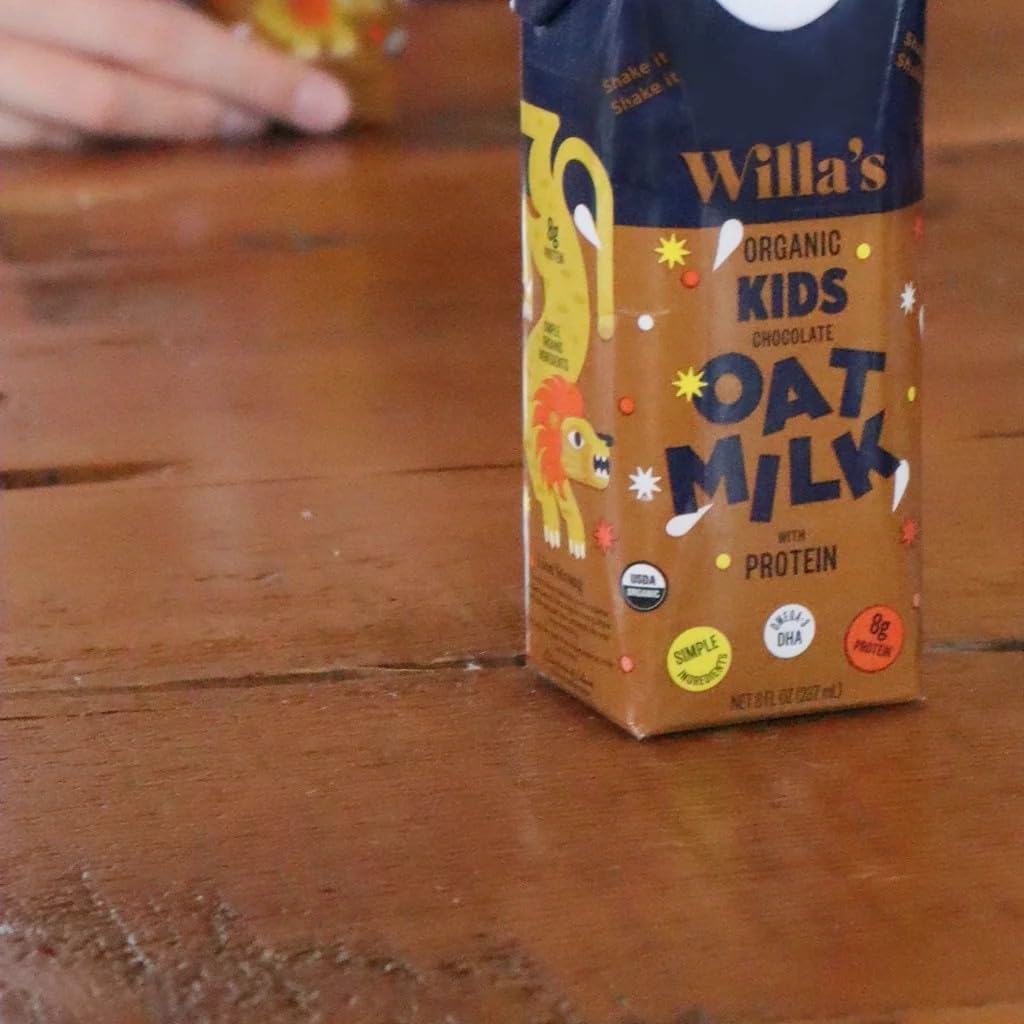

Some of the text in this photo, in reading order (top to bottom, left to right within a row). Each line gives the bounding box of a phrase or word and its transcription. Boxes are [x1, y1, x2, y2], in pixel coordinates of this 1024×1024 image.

[602, 63, 650, 94] Shake
[610, 82, 663, 115] Shake
[681, 137, 888, 204] Willa's
[743, 229, 842, 263] ORGANIC
[737, 268, 848, 323] KIDS
[752, 324, 834, 348] CHOCOLATE
[693, 347, 887, 436] OAT
[665, 409, 901, 523] MILK
[744, 545, 838, 580] PROTEIN
[630, 574, 656, 585] USDA
[777, 630, 803, 647] DHA
[870, 613, 891, 642] 8g
[673, 634, 719, 665] SIMPLE
[854, 639, 893, 657] PROTEIN
[676, 652, 728, 686] INGREDIENTS
